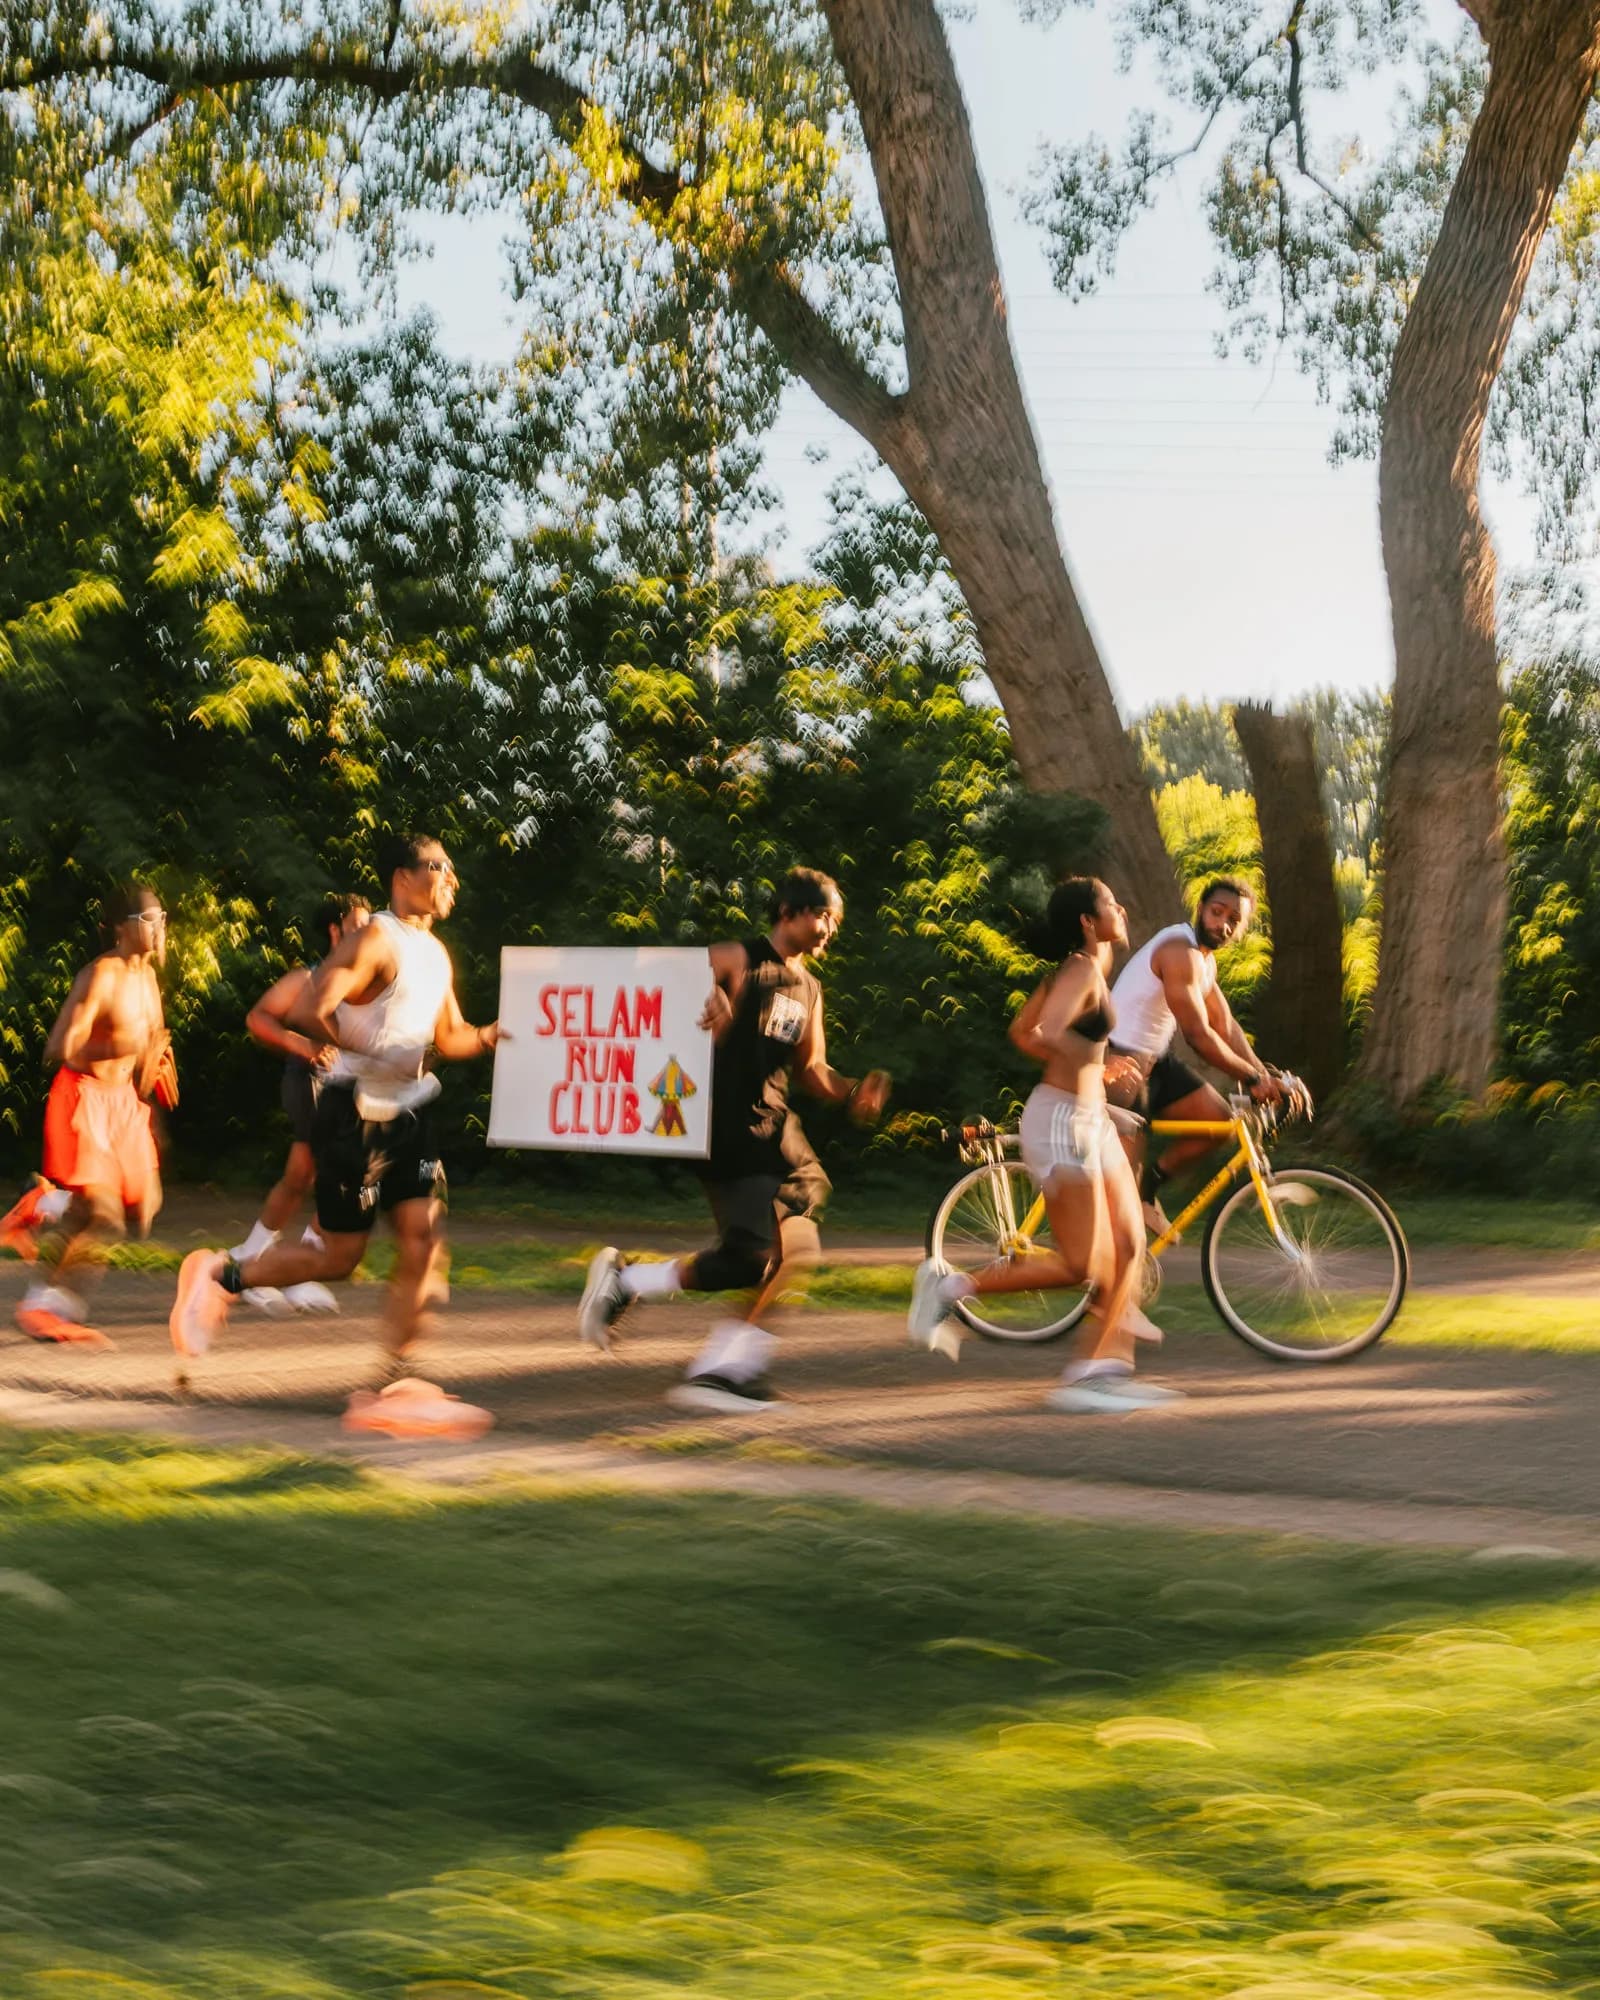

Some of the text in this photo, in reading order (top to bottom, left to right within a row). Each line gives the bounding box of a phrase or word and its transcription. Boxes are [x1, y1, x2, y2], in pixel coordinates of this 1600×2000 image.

[535, 984, 663, 1038] SELAM
[565, 1039, 636, 1084] RUN
[549, 1080, 642, 1135] CLUB
